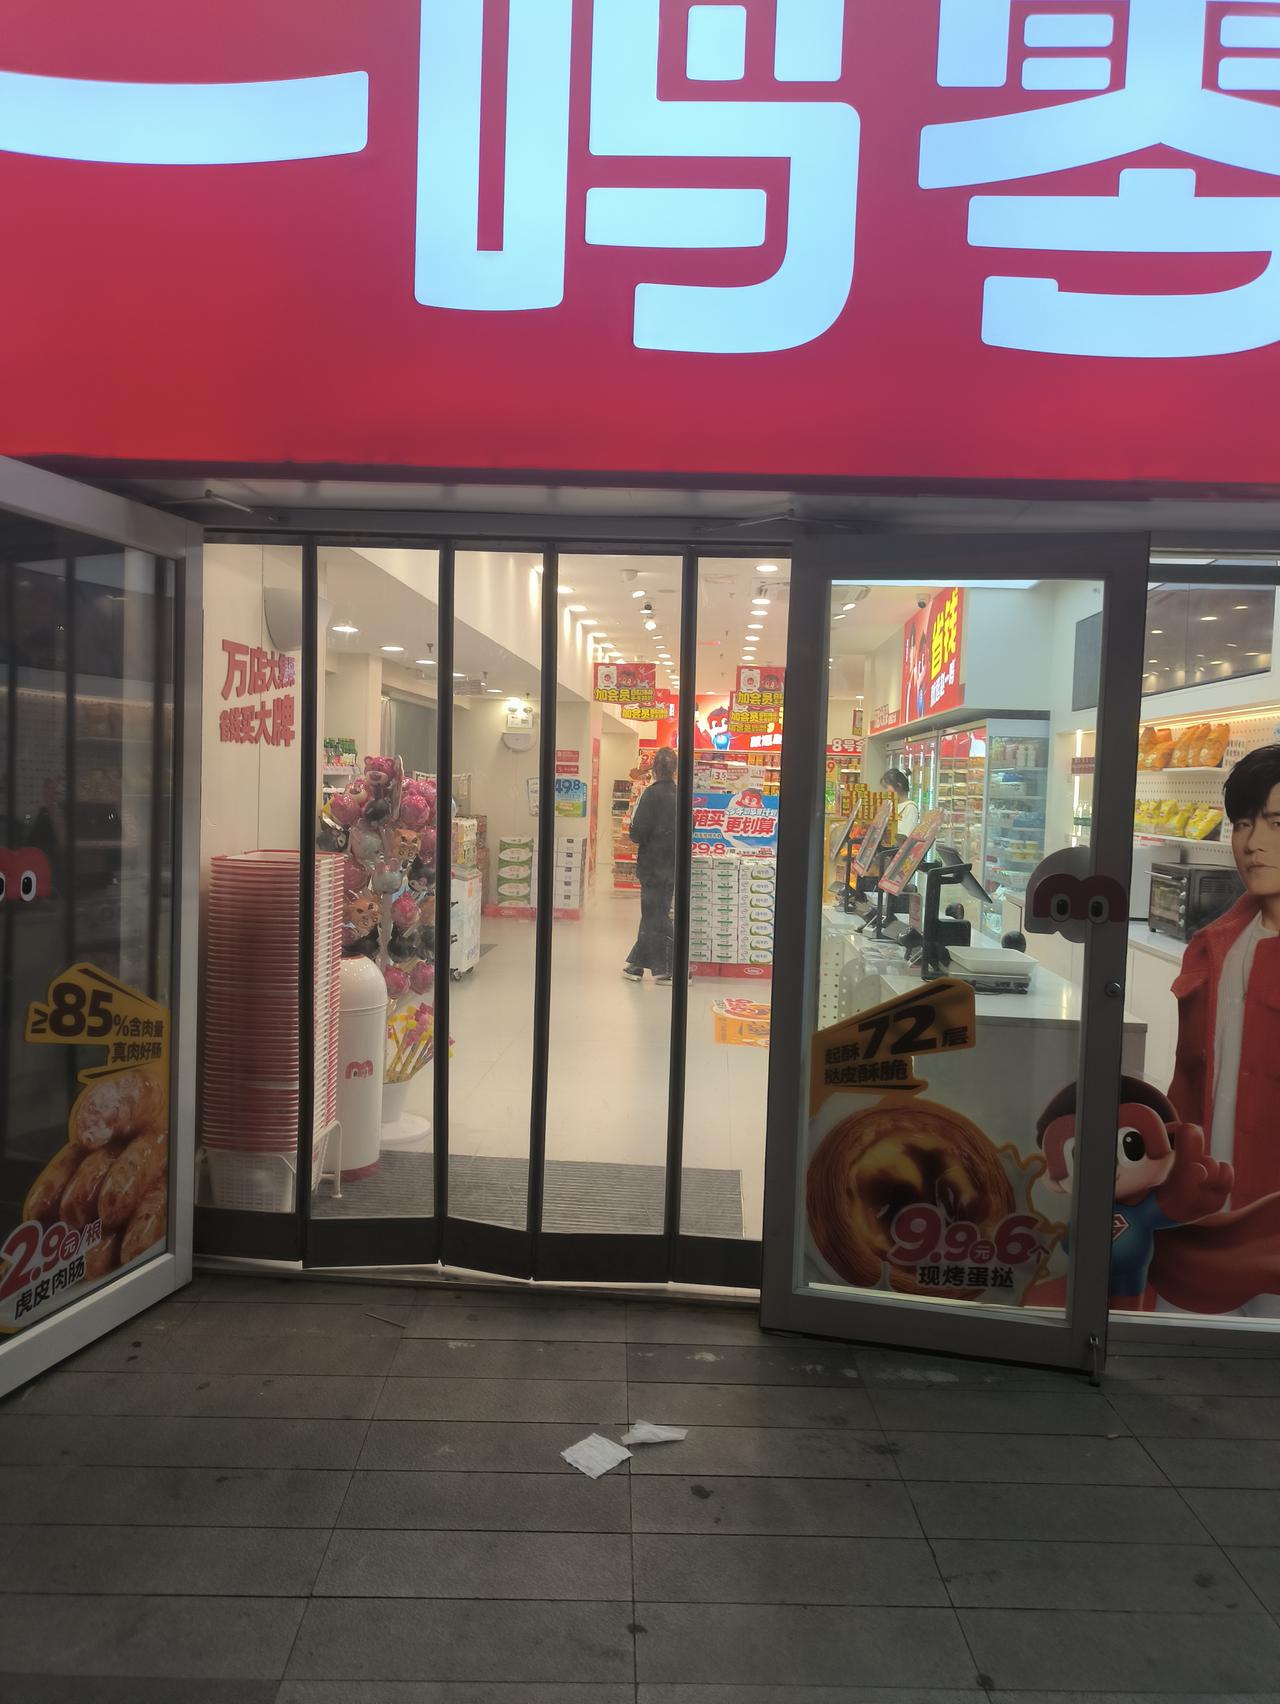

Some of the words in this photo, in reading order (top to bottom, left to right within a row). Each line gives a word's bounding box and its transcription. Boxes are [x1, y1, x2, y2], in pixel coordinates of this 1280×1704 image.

[724, 816, 776, 835] 更划算
[112, 1042, 162, 1063] 真肉好肠
[15, 1255, 85, 1320] 虎皮肉肠
[918, 1265, 1014, 1288] 现烤蛋挞
